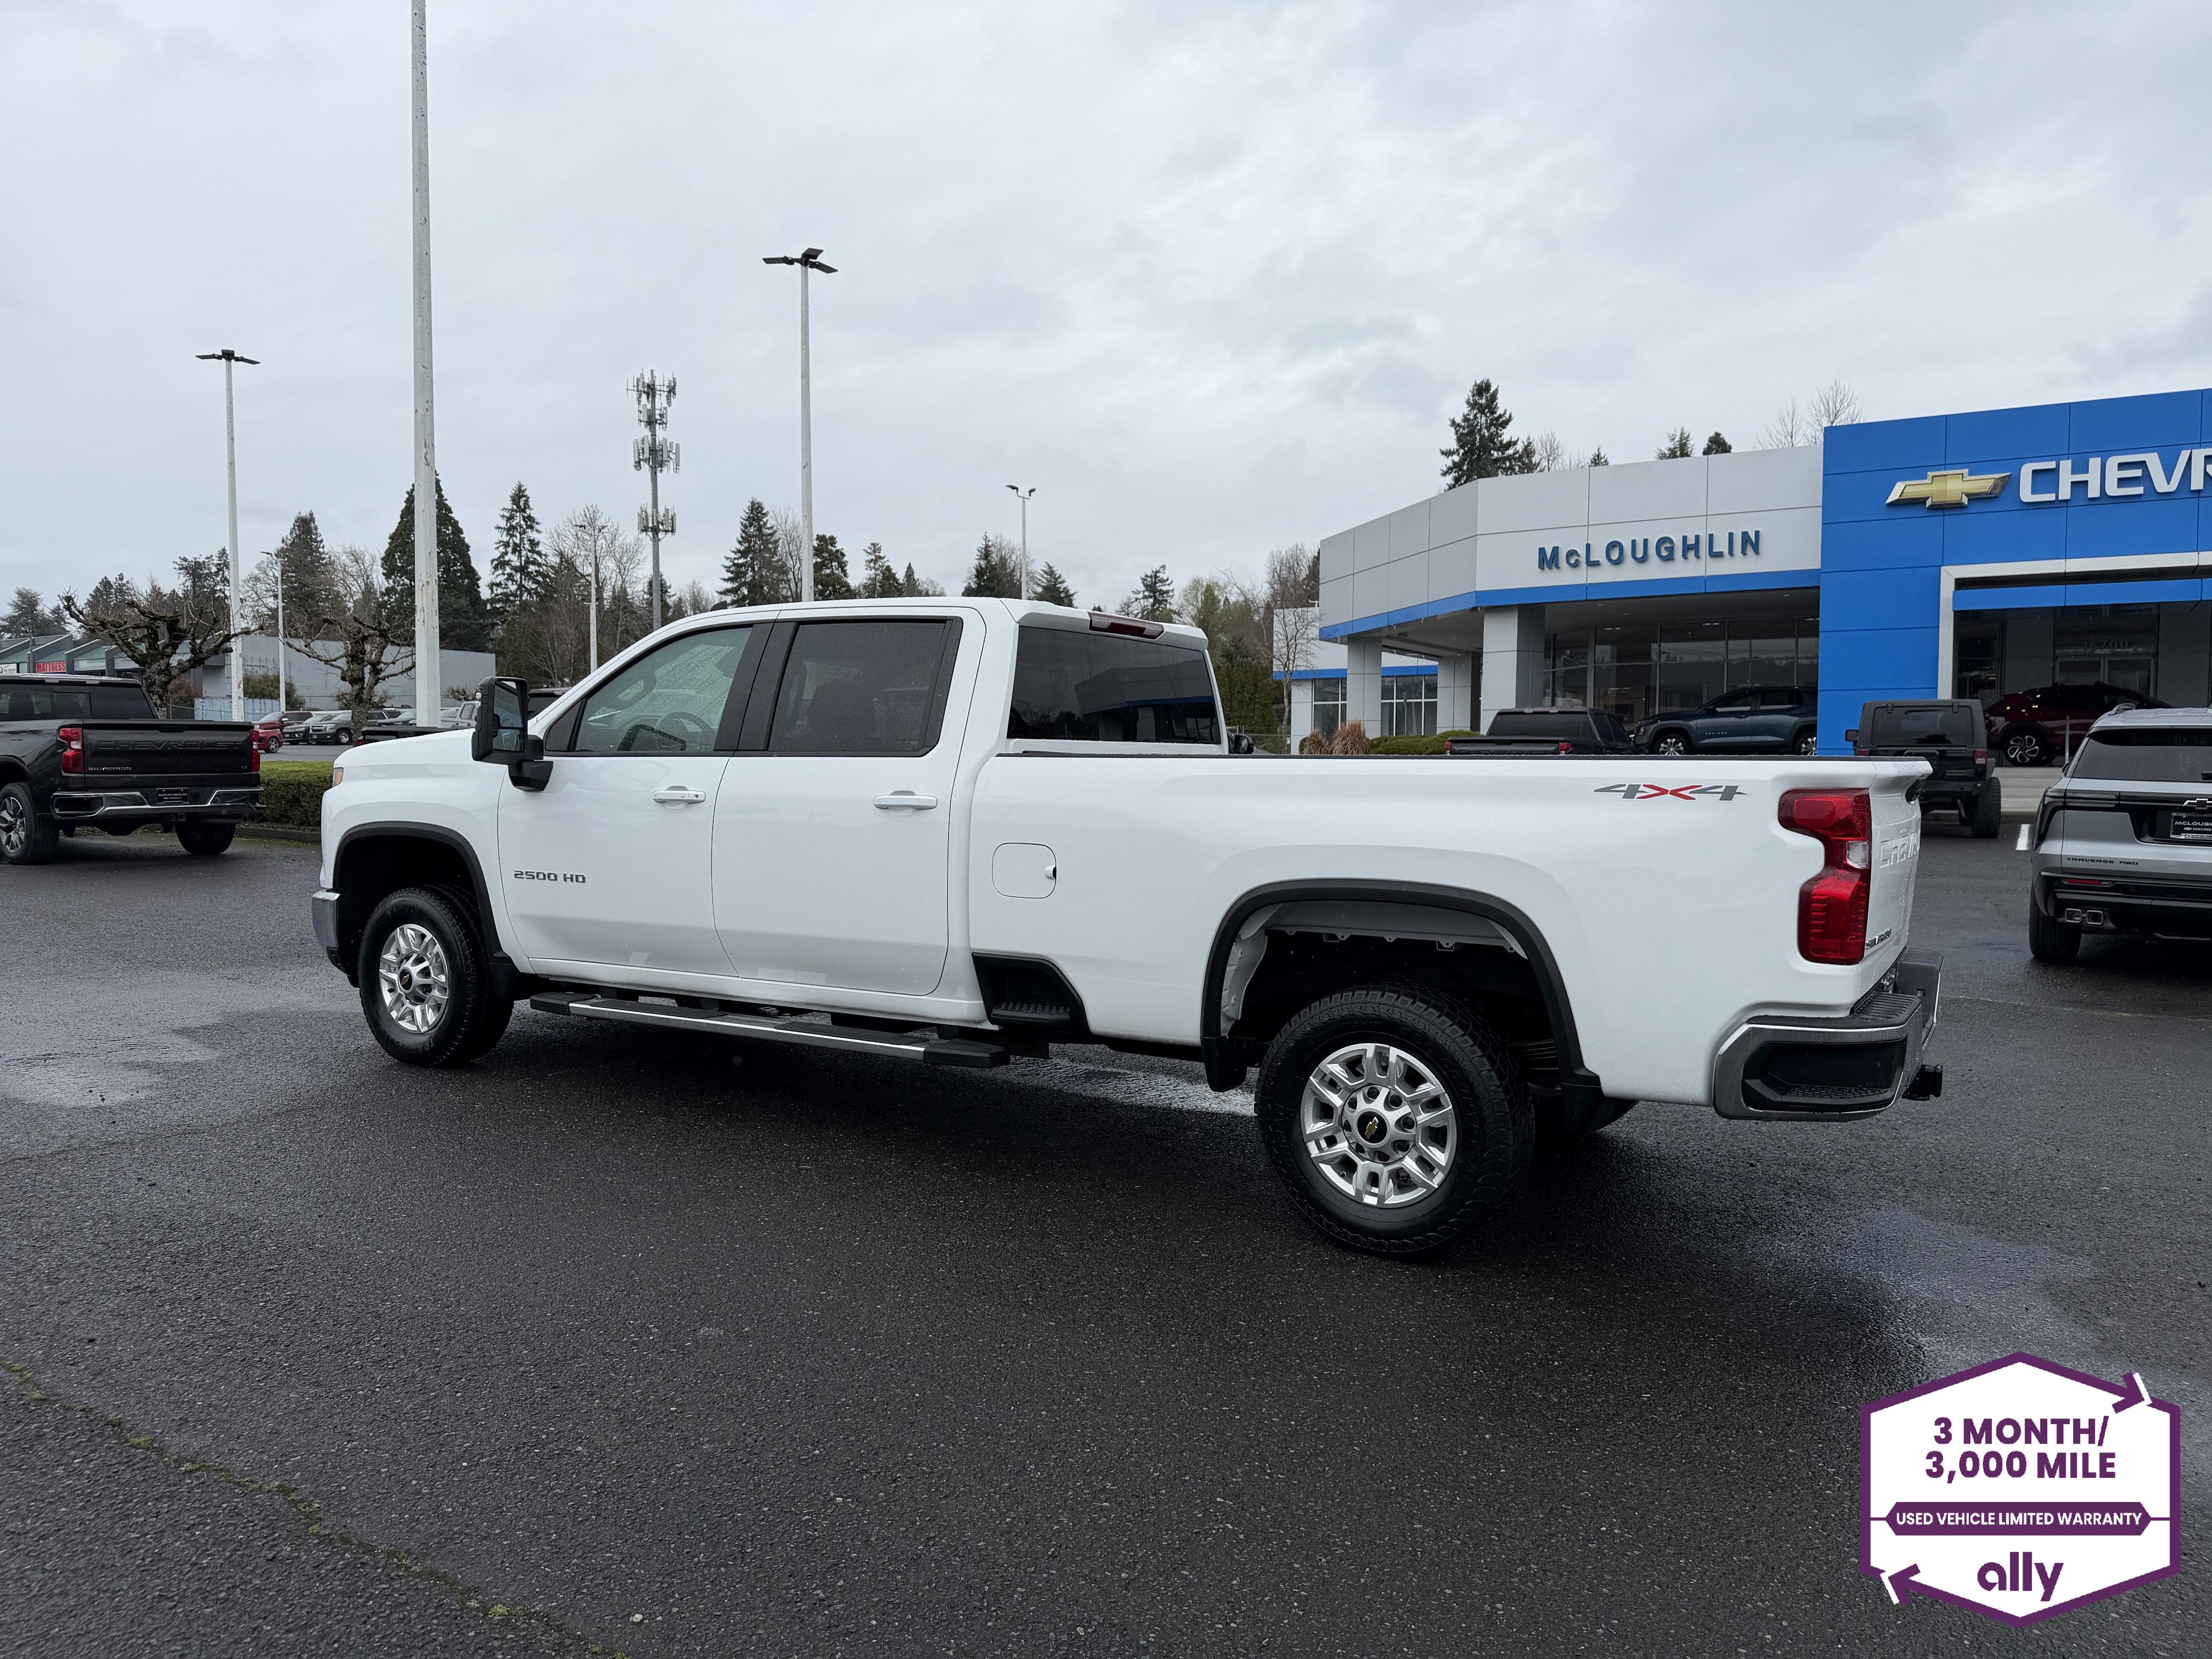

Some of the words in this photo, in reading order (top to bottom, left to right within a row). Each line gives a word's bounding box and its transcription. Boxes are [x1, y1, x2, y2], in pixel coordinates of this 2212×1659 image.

[1538, 530, 1760, 570] McLOUGHLIN
[2083, 639, 2128, 651] 16700
[36, 662, 66, 673] MATTRESS
[98, 741, 242, 749] CHEVROLET
[514, 870, 558, 881] 2500
[563, 874, 586, 883] HD
